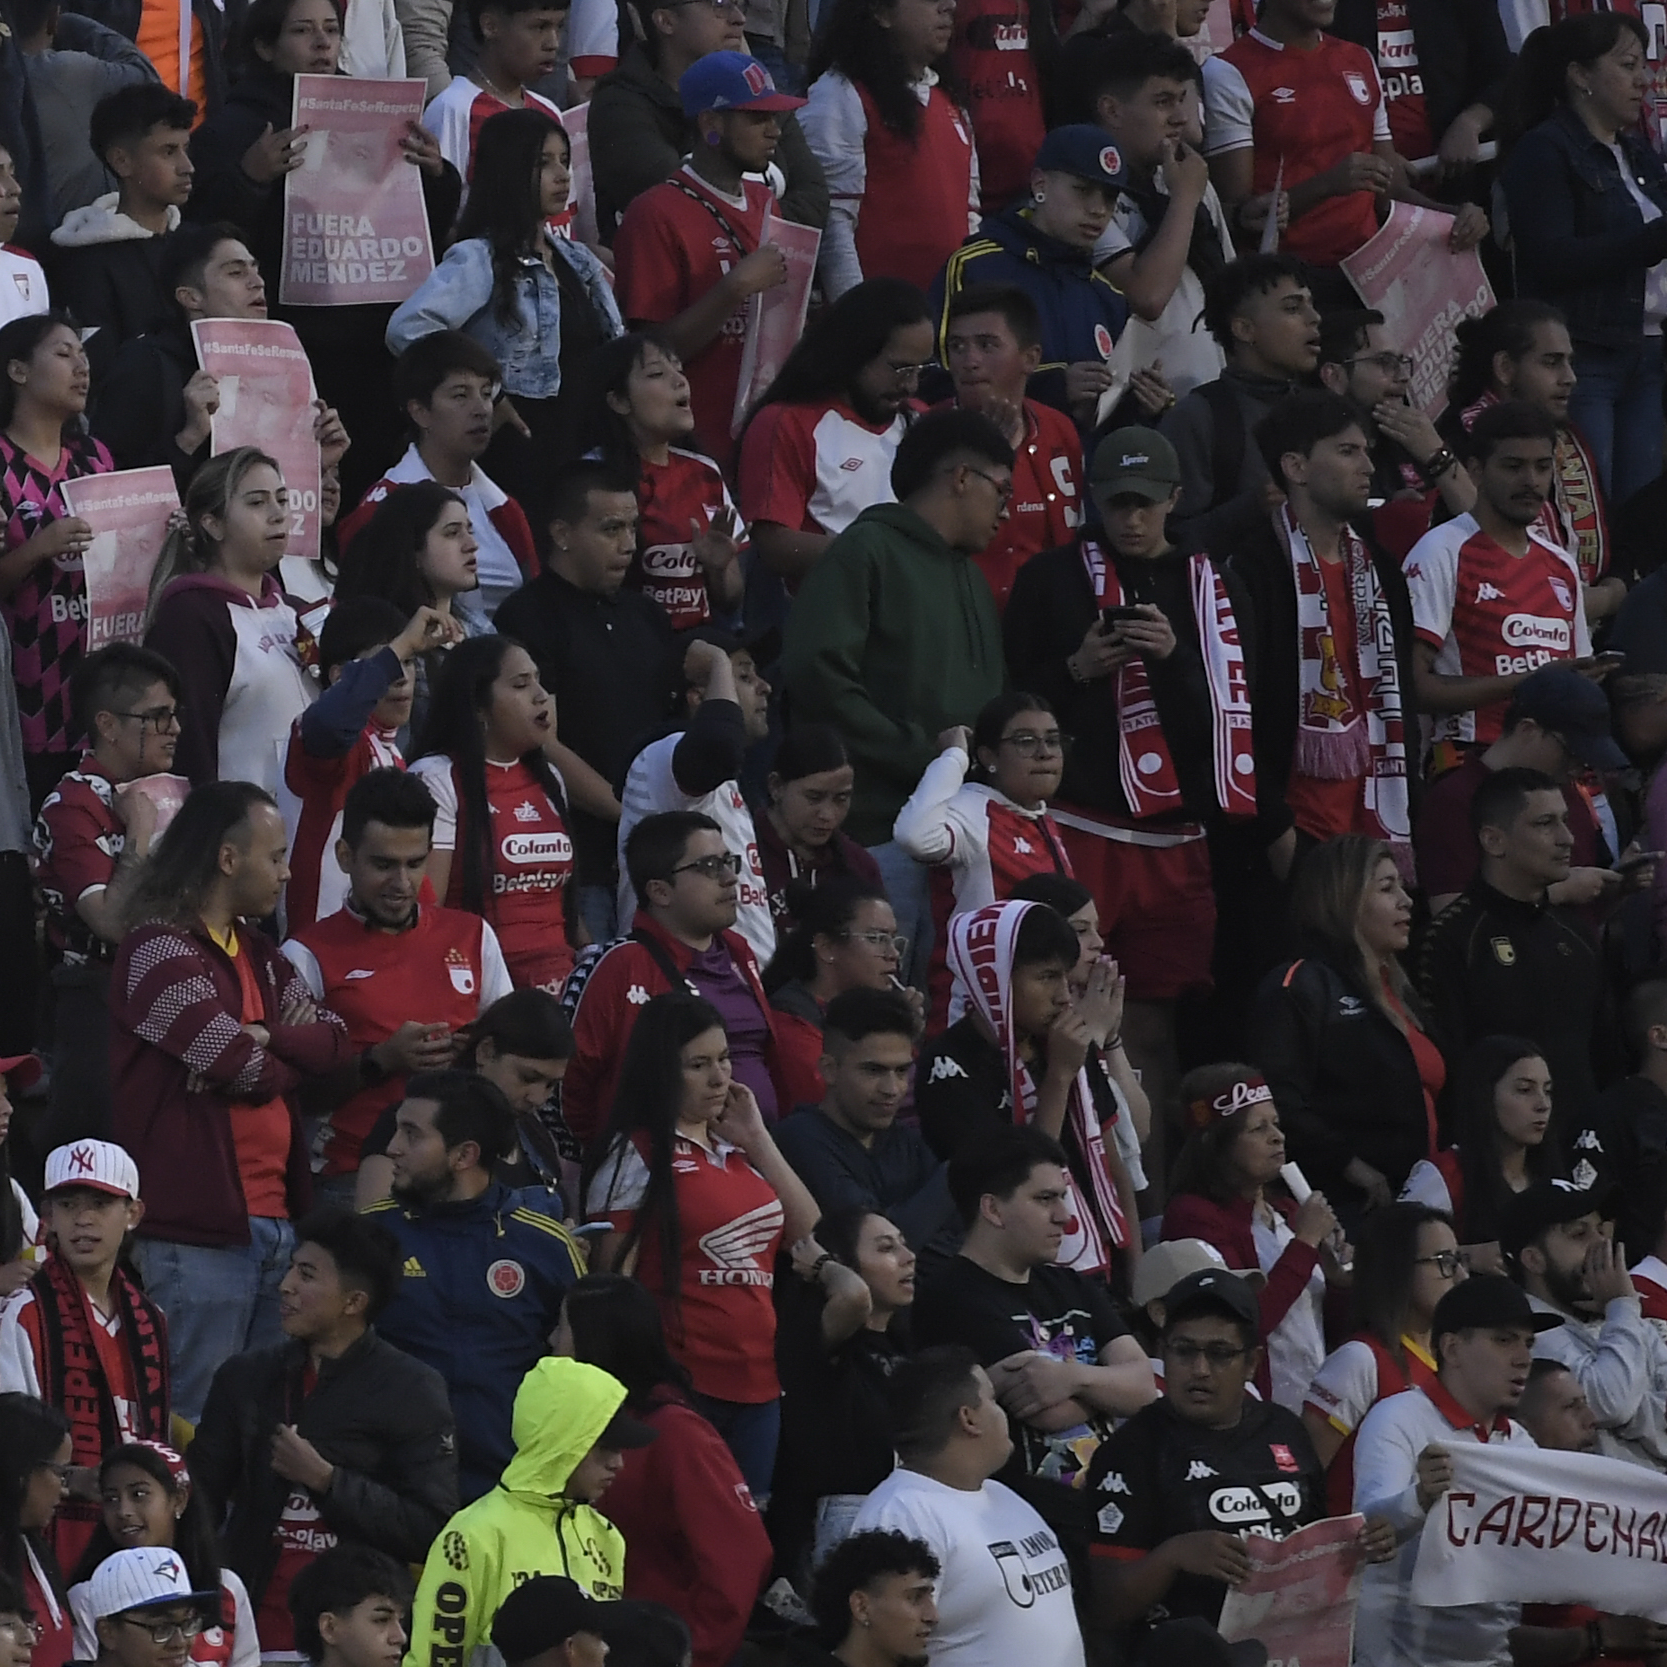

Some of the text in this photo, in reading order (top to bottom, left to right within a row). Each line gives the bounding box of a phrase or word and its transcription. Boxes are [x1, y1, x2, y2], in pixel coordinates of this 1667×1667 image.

[291, 213, 375, 237] FUERA
[291, 237, 425, 261] EDUARDO
[291, 260, 407, 284] MENDEZ
[1413, 298, 1462, 362] UERA
[1447, 1492, 1667, 1564] CARDENA
